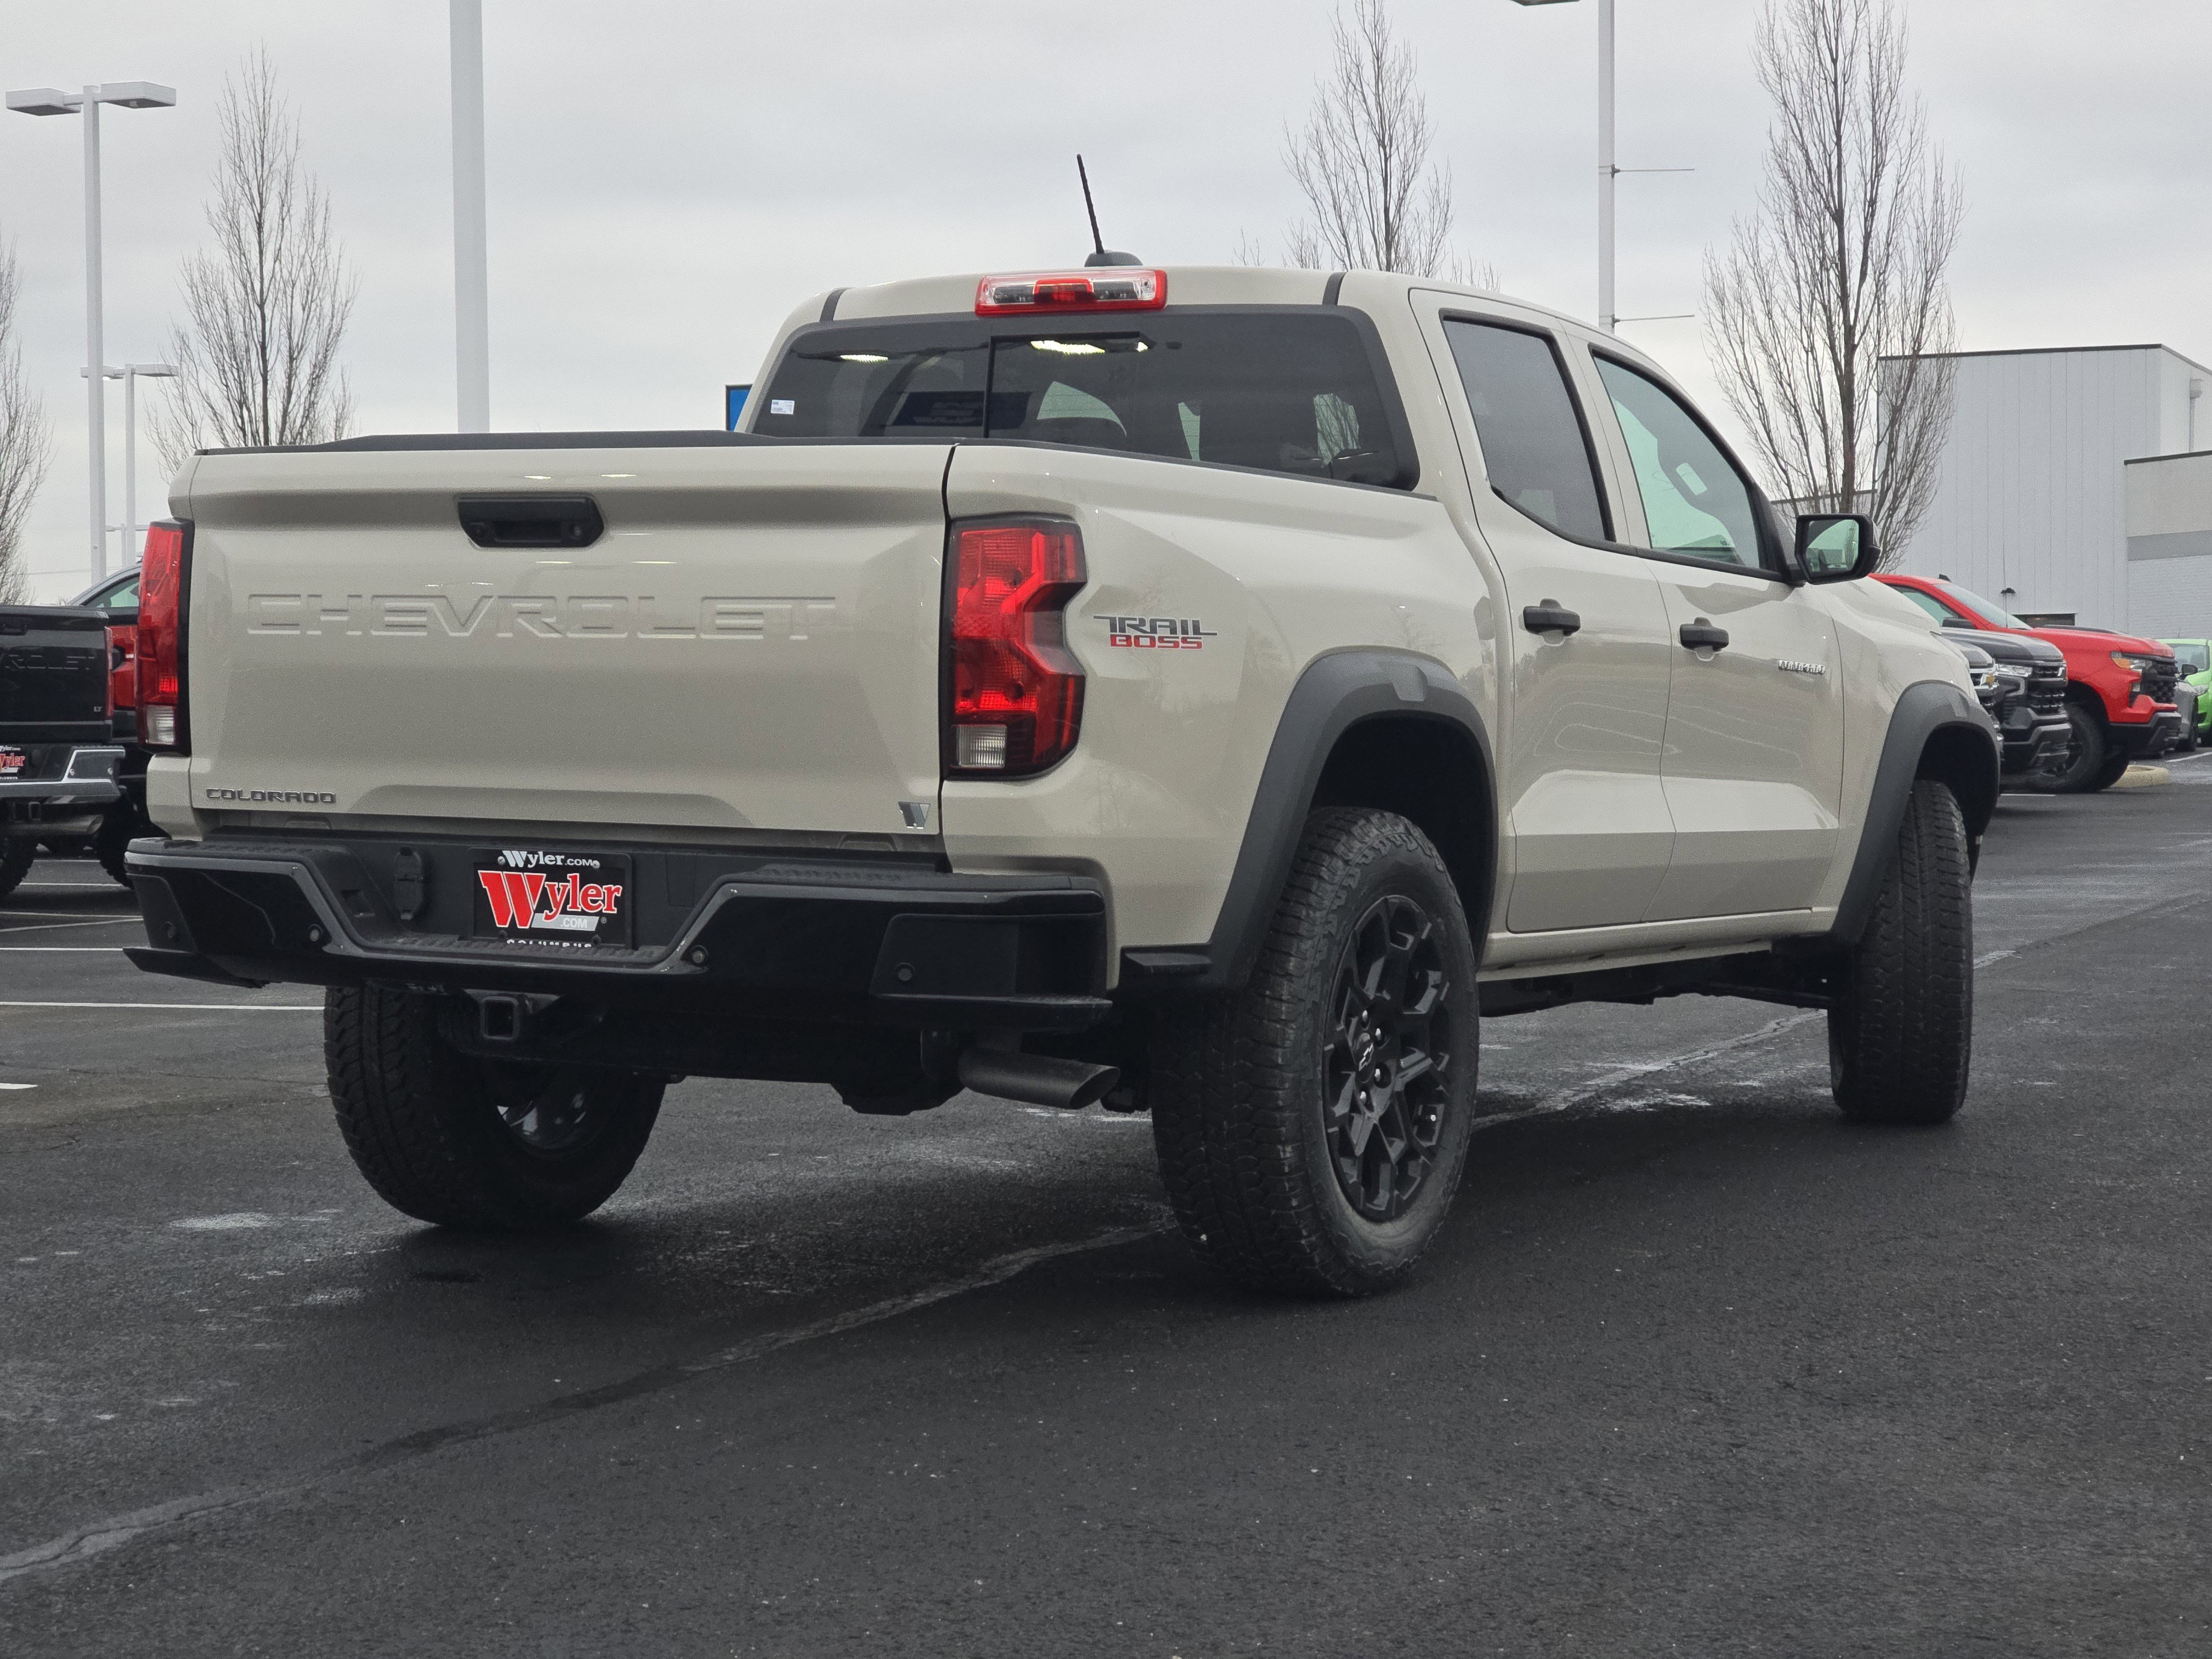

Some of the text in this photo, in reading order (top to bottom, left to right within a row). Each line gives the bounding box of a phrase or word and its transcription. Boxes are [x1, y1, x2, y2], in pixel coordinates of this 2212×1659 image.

[247, 593, 837, 641] CHEVROLET
[1093, 615, 1218, 637] TRAIL
[1110, 634, 1203, 650] BOSS
[206, 787, 337, 803] COLORADO
[478, 870, 623, 929] Wyler
